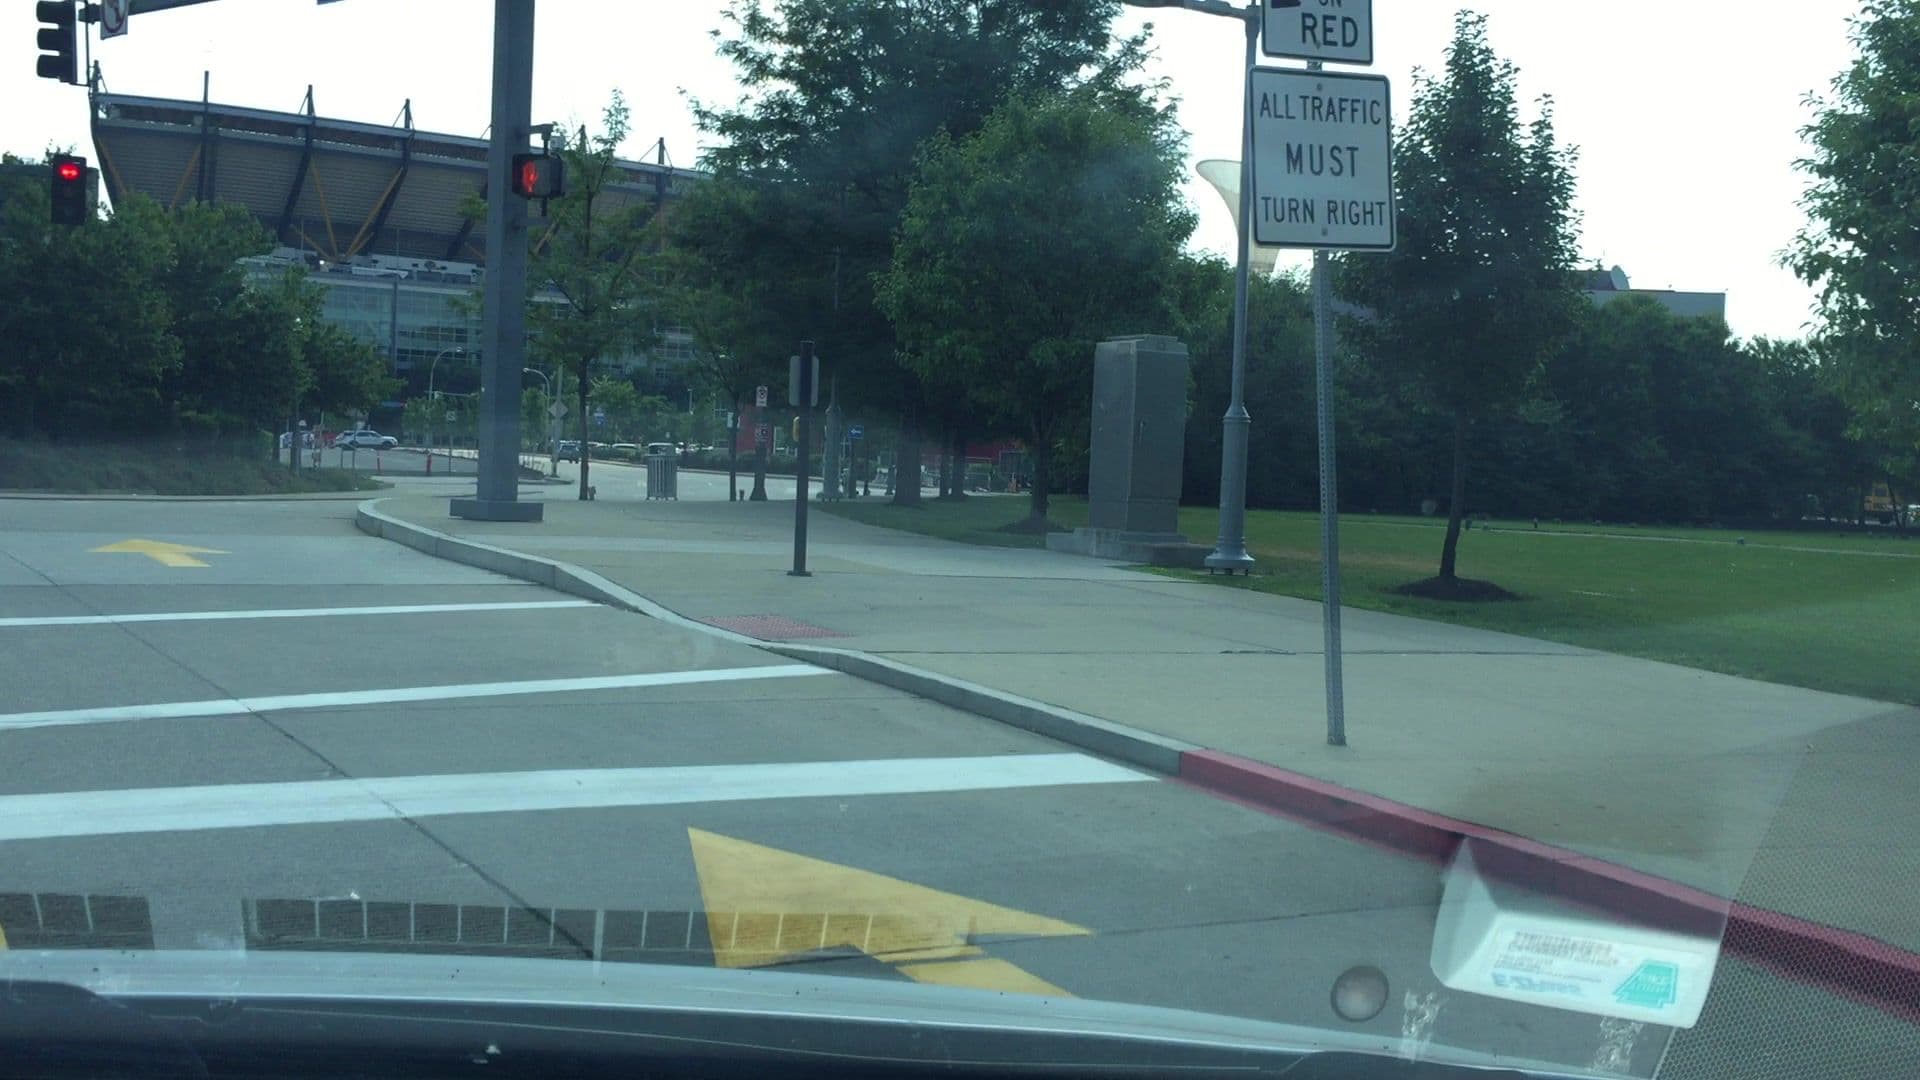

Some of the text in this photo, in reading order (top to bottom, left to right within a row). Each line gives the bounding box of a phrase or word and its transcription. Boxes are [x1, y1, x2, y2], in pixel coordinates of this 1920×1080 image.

[1301, 12, 1358, 47] RED
[1260, 93, 1382, 125] ALL TRAFFIC
[1286, 143, 1359, 177] MUST
[1261, 196, 1386, 226] TURN RIGHT
